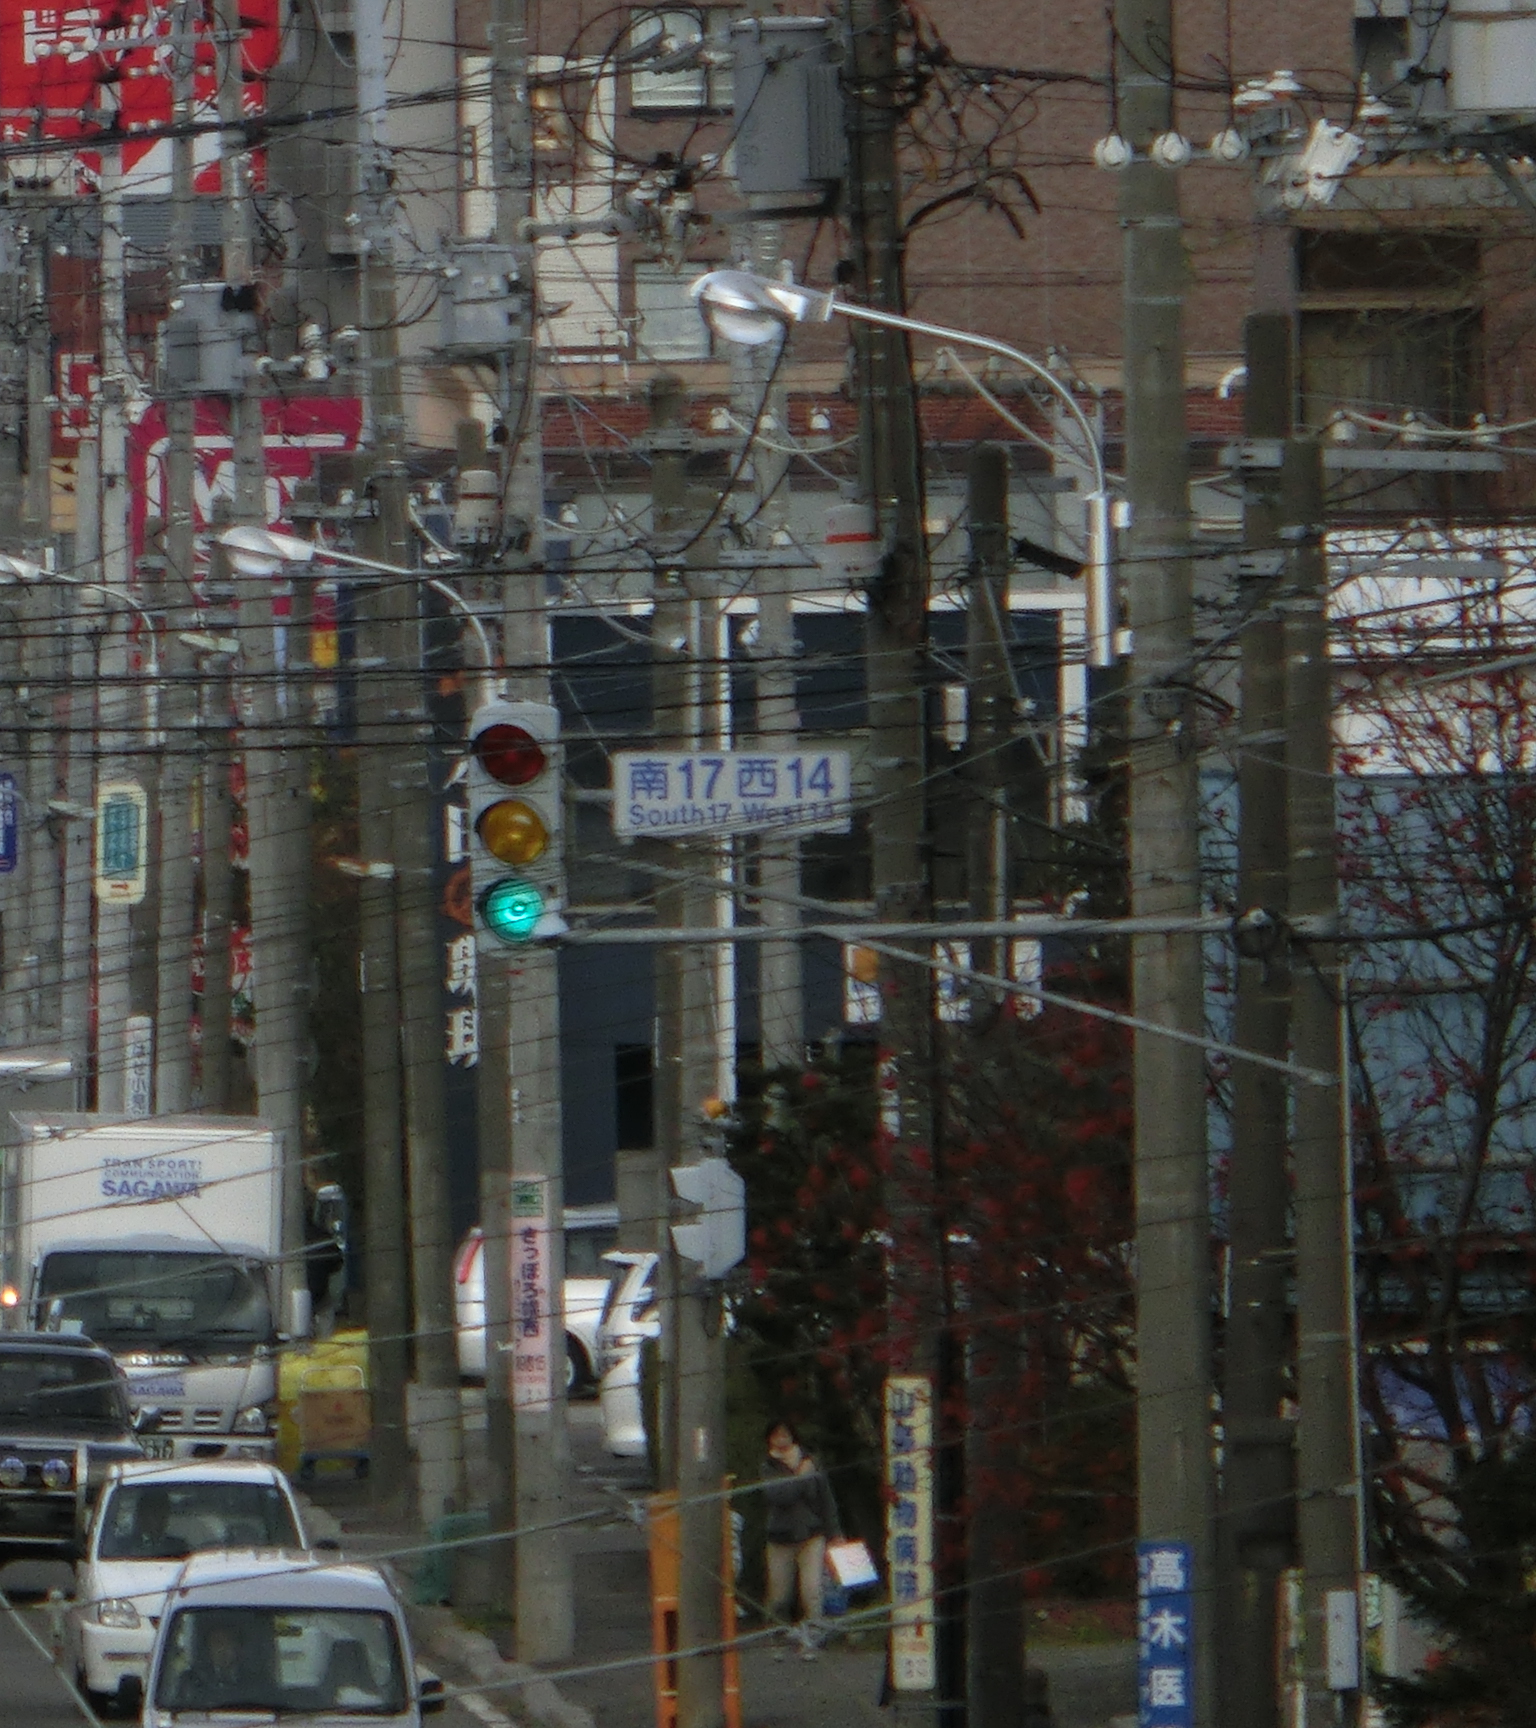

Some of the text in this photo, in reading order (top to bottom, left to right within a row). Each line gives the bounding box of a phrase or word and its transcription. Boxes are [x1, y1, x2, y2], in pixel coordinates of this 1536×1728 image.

[629, 756, 835, 801] 南17西14
[631, 803, 732, 825] South17
[1148, 1550, 1187, 1712] 高木医
